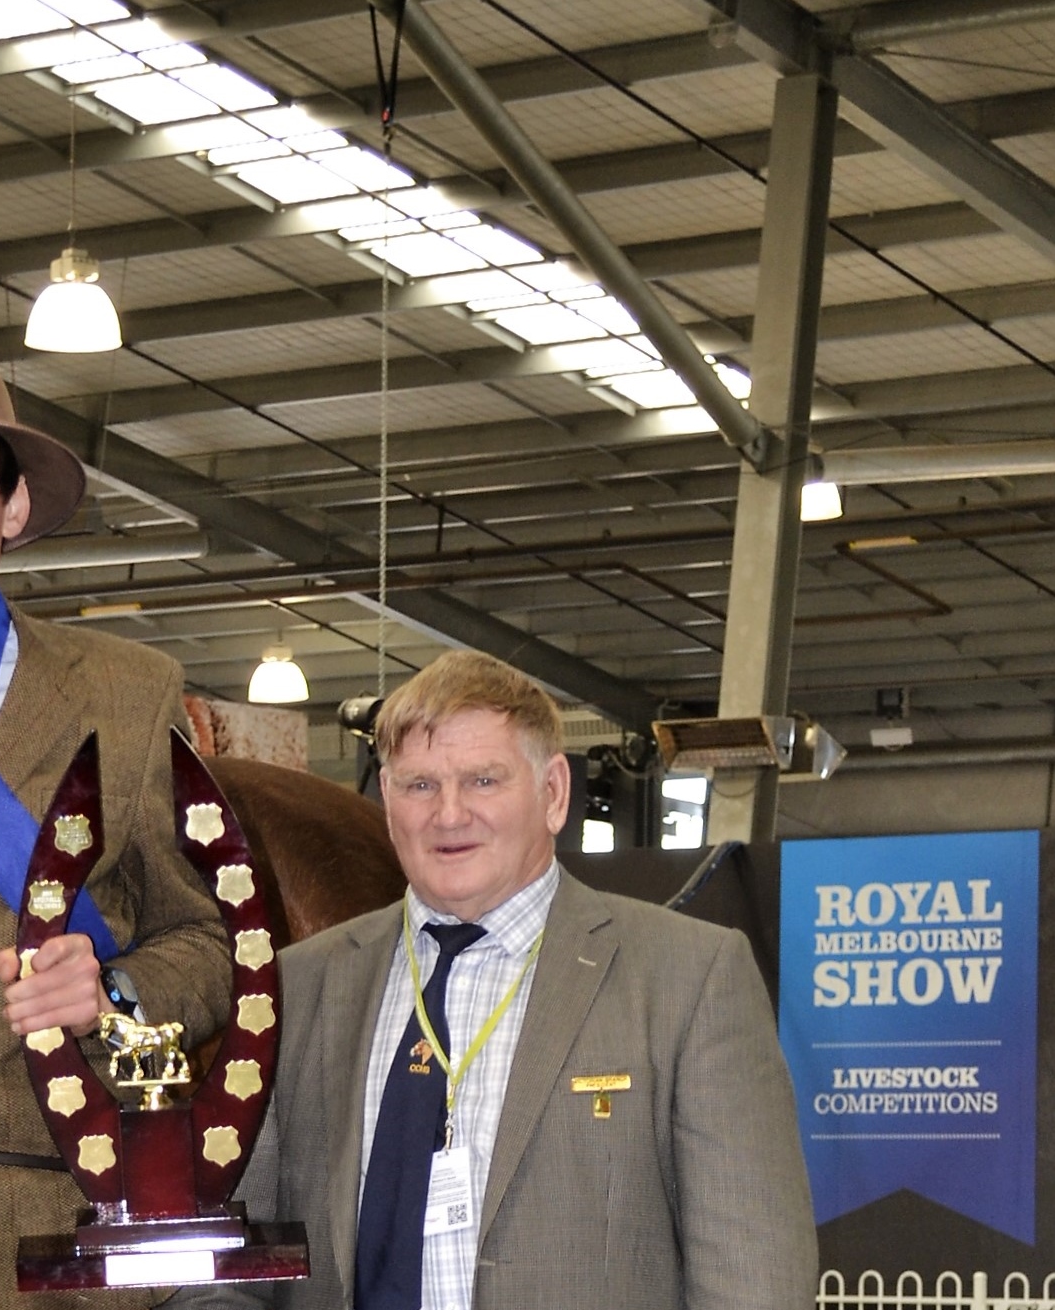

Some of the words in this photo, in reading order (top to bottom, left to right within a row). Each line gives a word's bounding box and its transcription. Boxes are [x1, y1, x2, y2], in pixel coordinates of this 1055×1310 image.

[814, 879, 1003, 927] ROYAL
[814, 927, 1002, 956] MELBOURNE
[812, 957, 1003, 1008] SHOW
[833, 1066, 980, 1090] LIVESTOCK
[814, 1091, 998, 1115] COMPETITIONS
